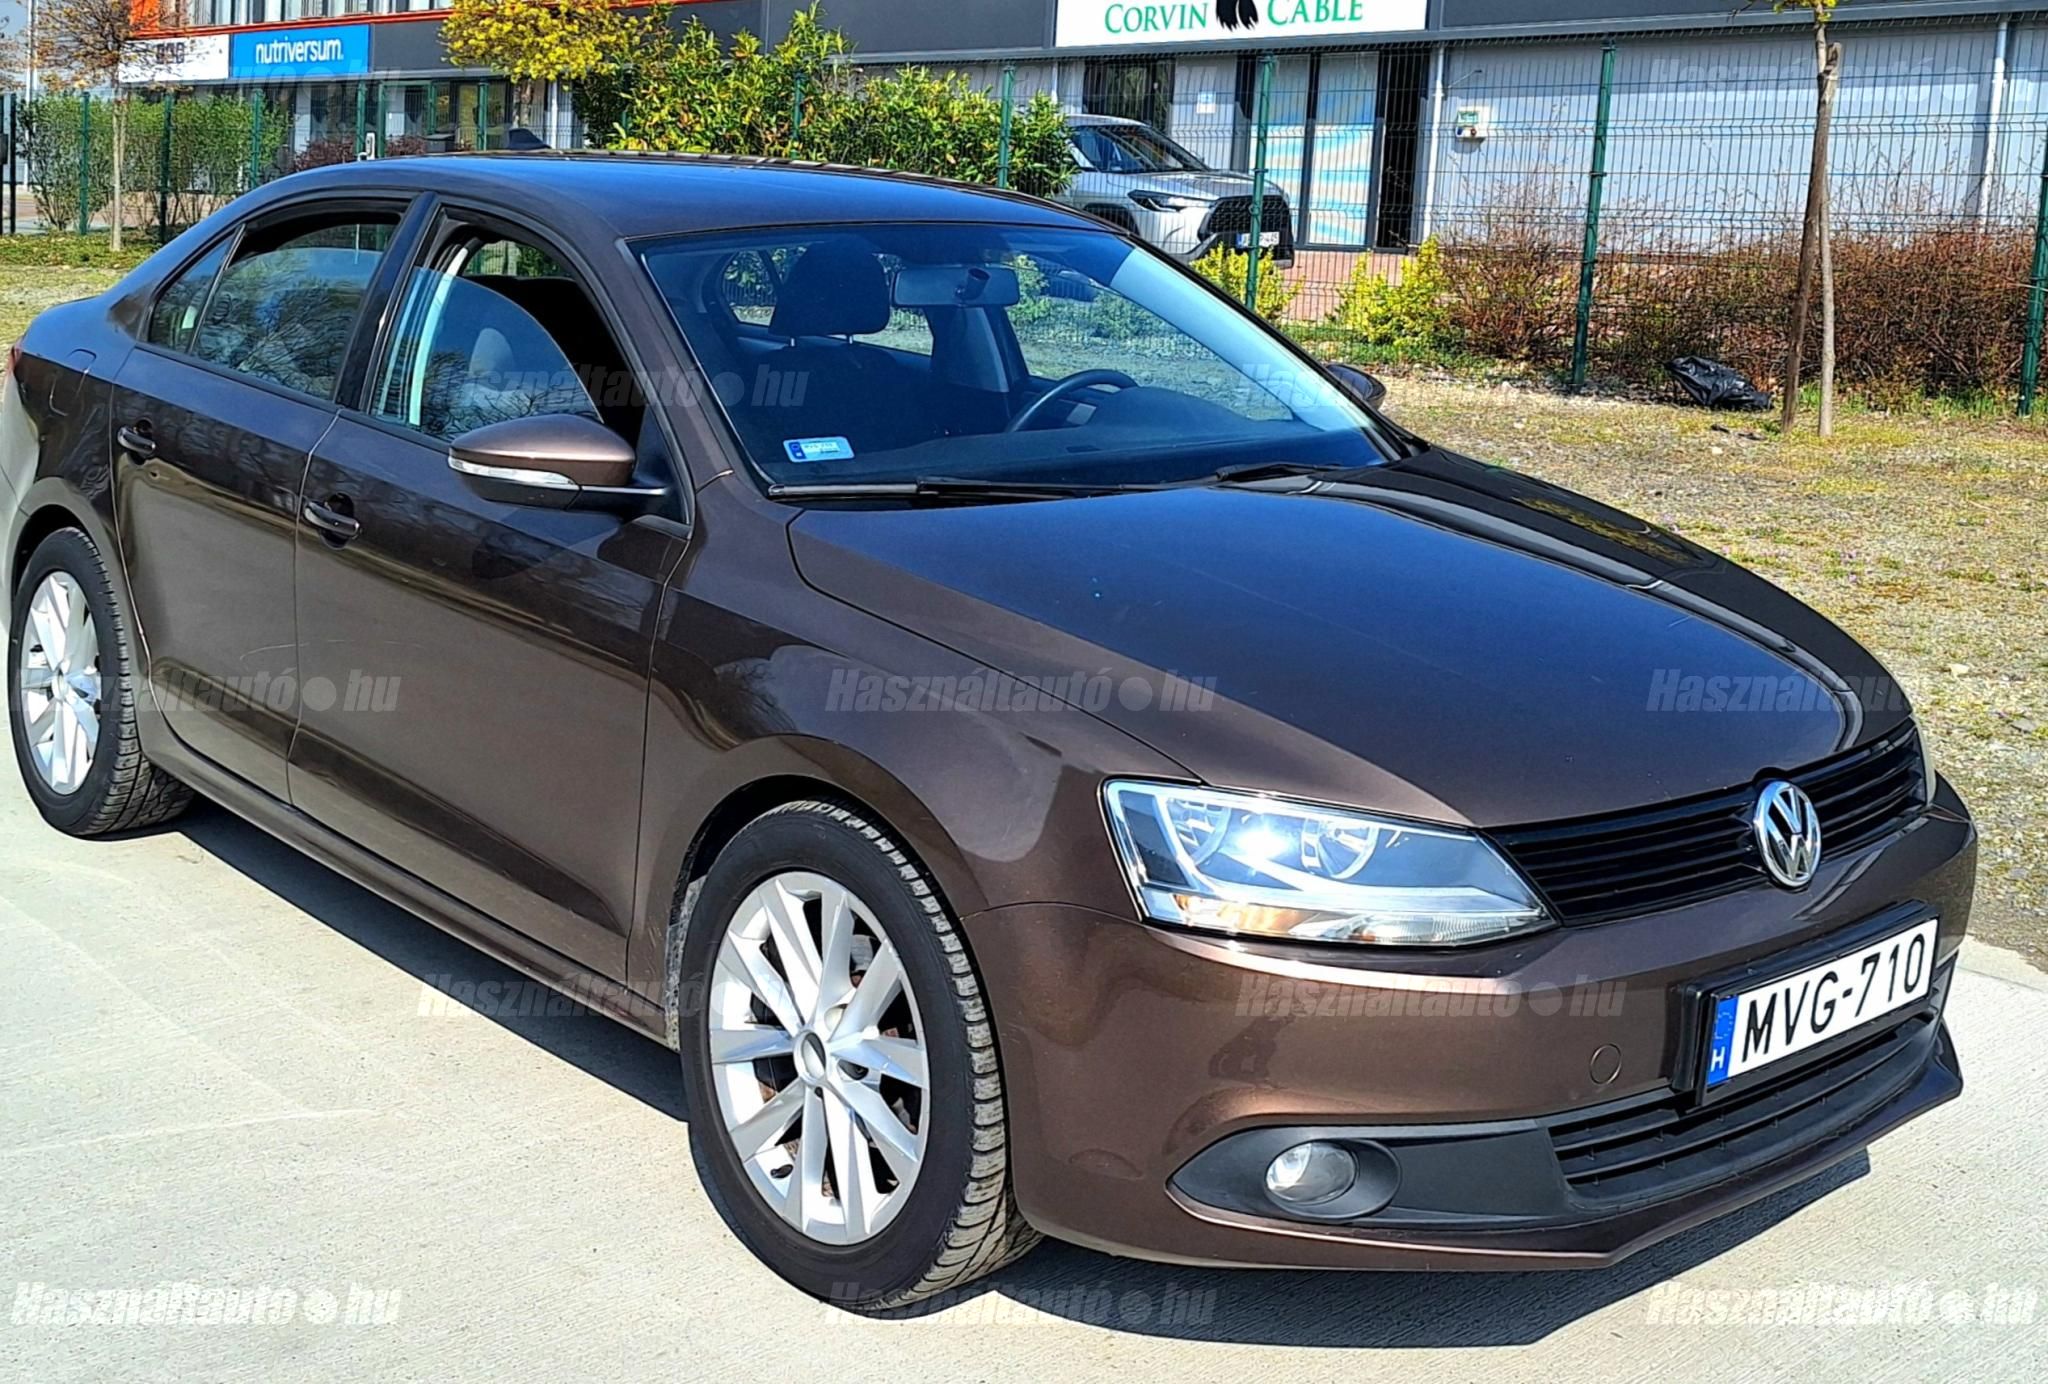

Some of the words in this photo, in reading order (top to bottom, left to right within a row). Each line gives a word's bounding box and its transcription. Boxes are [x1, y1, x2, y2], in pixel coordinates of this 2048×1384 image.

[1104, 3, 1208, 34] CORVIN
[1267, 0, 1363, 26] CABLE
[1742, 933, 1926, 1063] MVG-710
